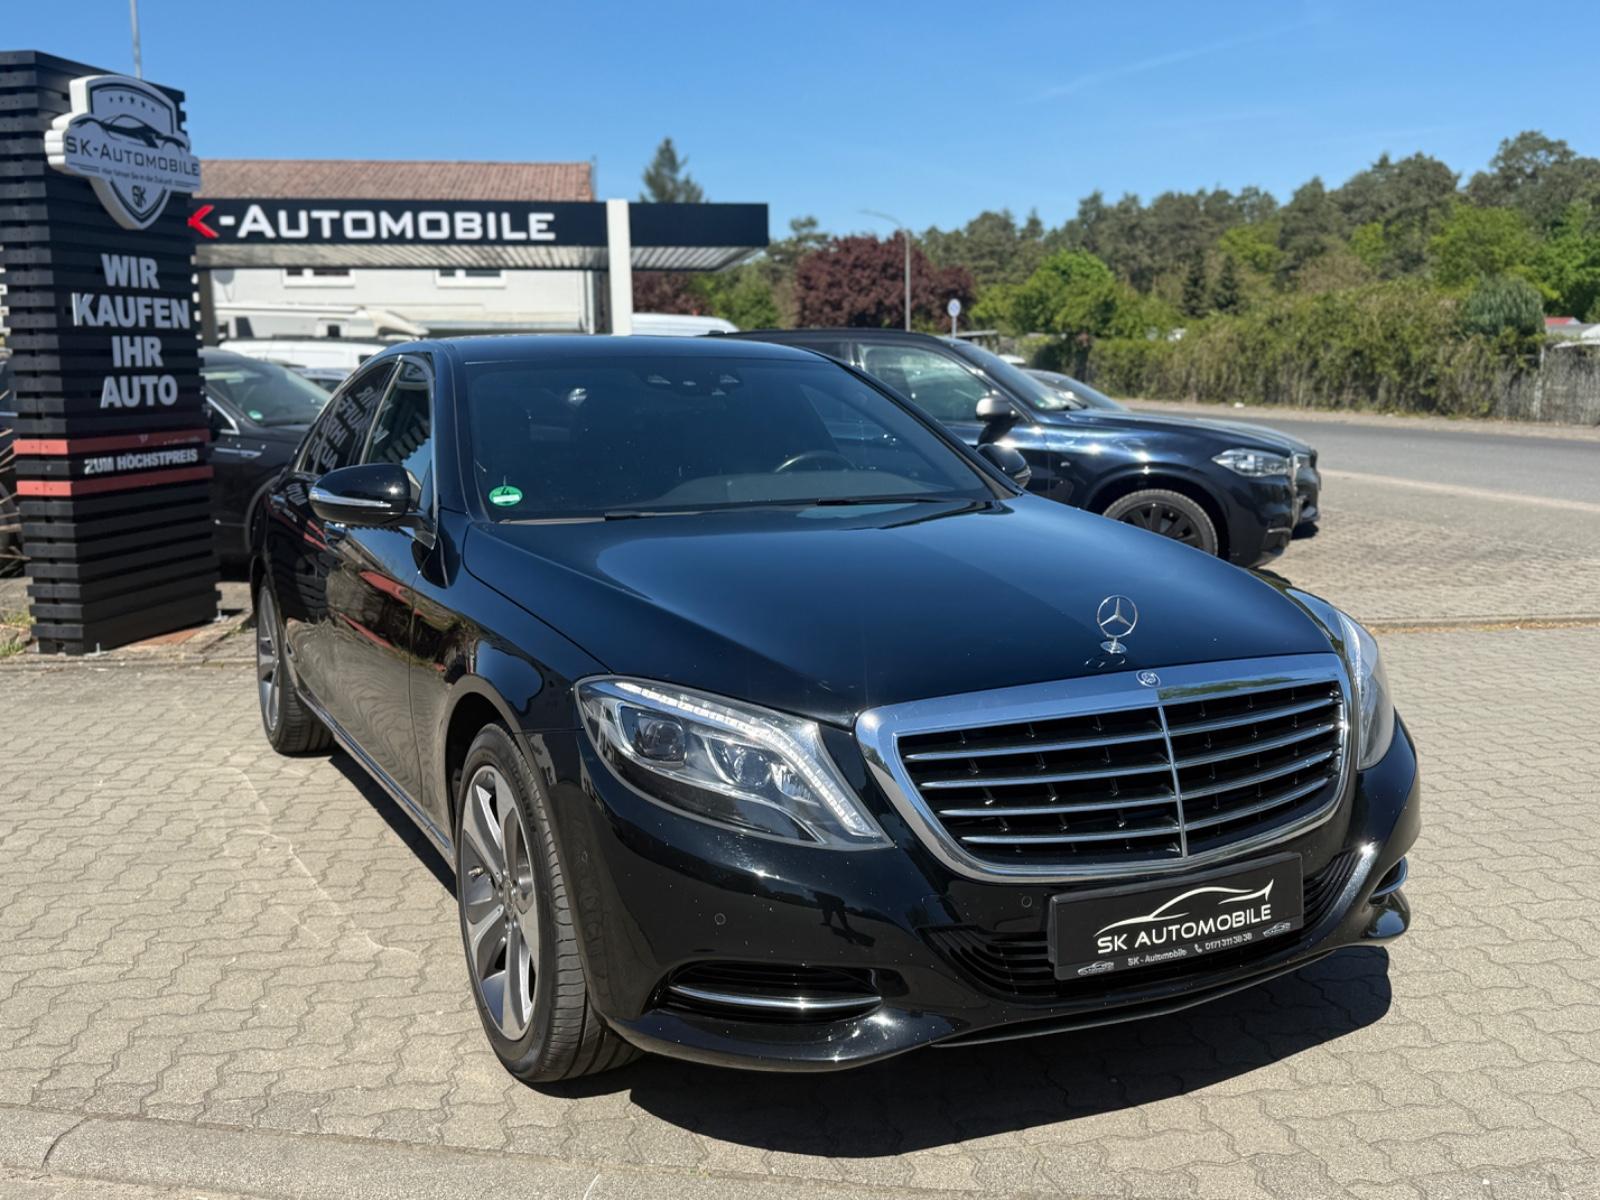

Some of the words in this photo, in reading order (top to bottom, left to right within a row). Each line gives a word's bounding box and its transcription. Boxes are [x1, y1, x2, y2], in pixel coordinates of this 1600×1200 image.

[101, 253, 160, 290] WIR
[72, 292, 190, 329] KAUFEN
[112, 336, 164, 368] IHR
[100, 375, 178, 409] AUTO
[84, 456, 114, 475] ZUM
[116, 448, 198, 471] HÖCHSTPREIS
[1097, 933, 1128, 954] SK
[1134, 903, 1272, 949] AUTOMOBILE
